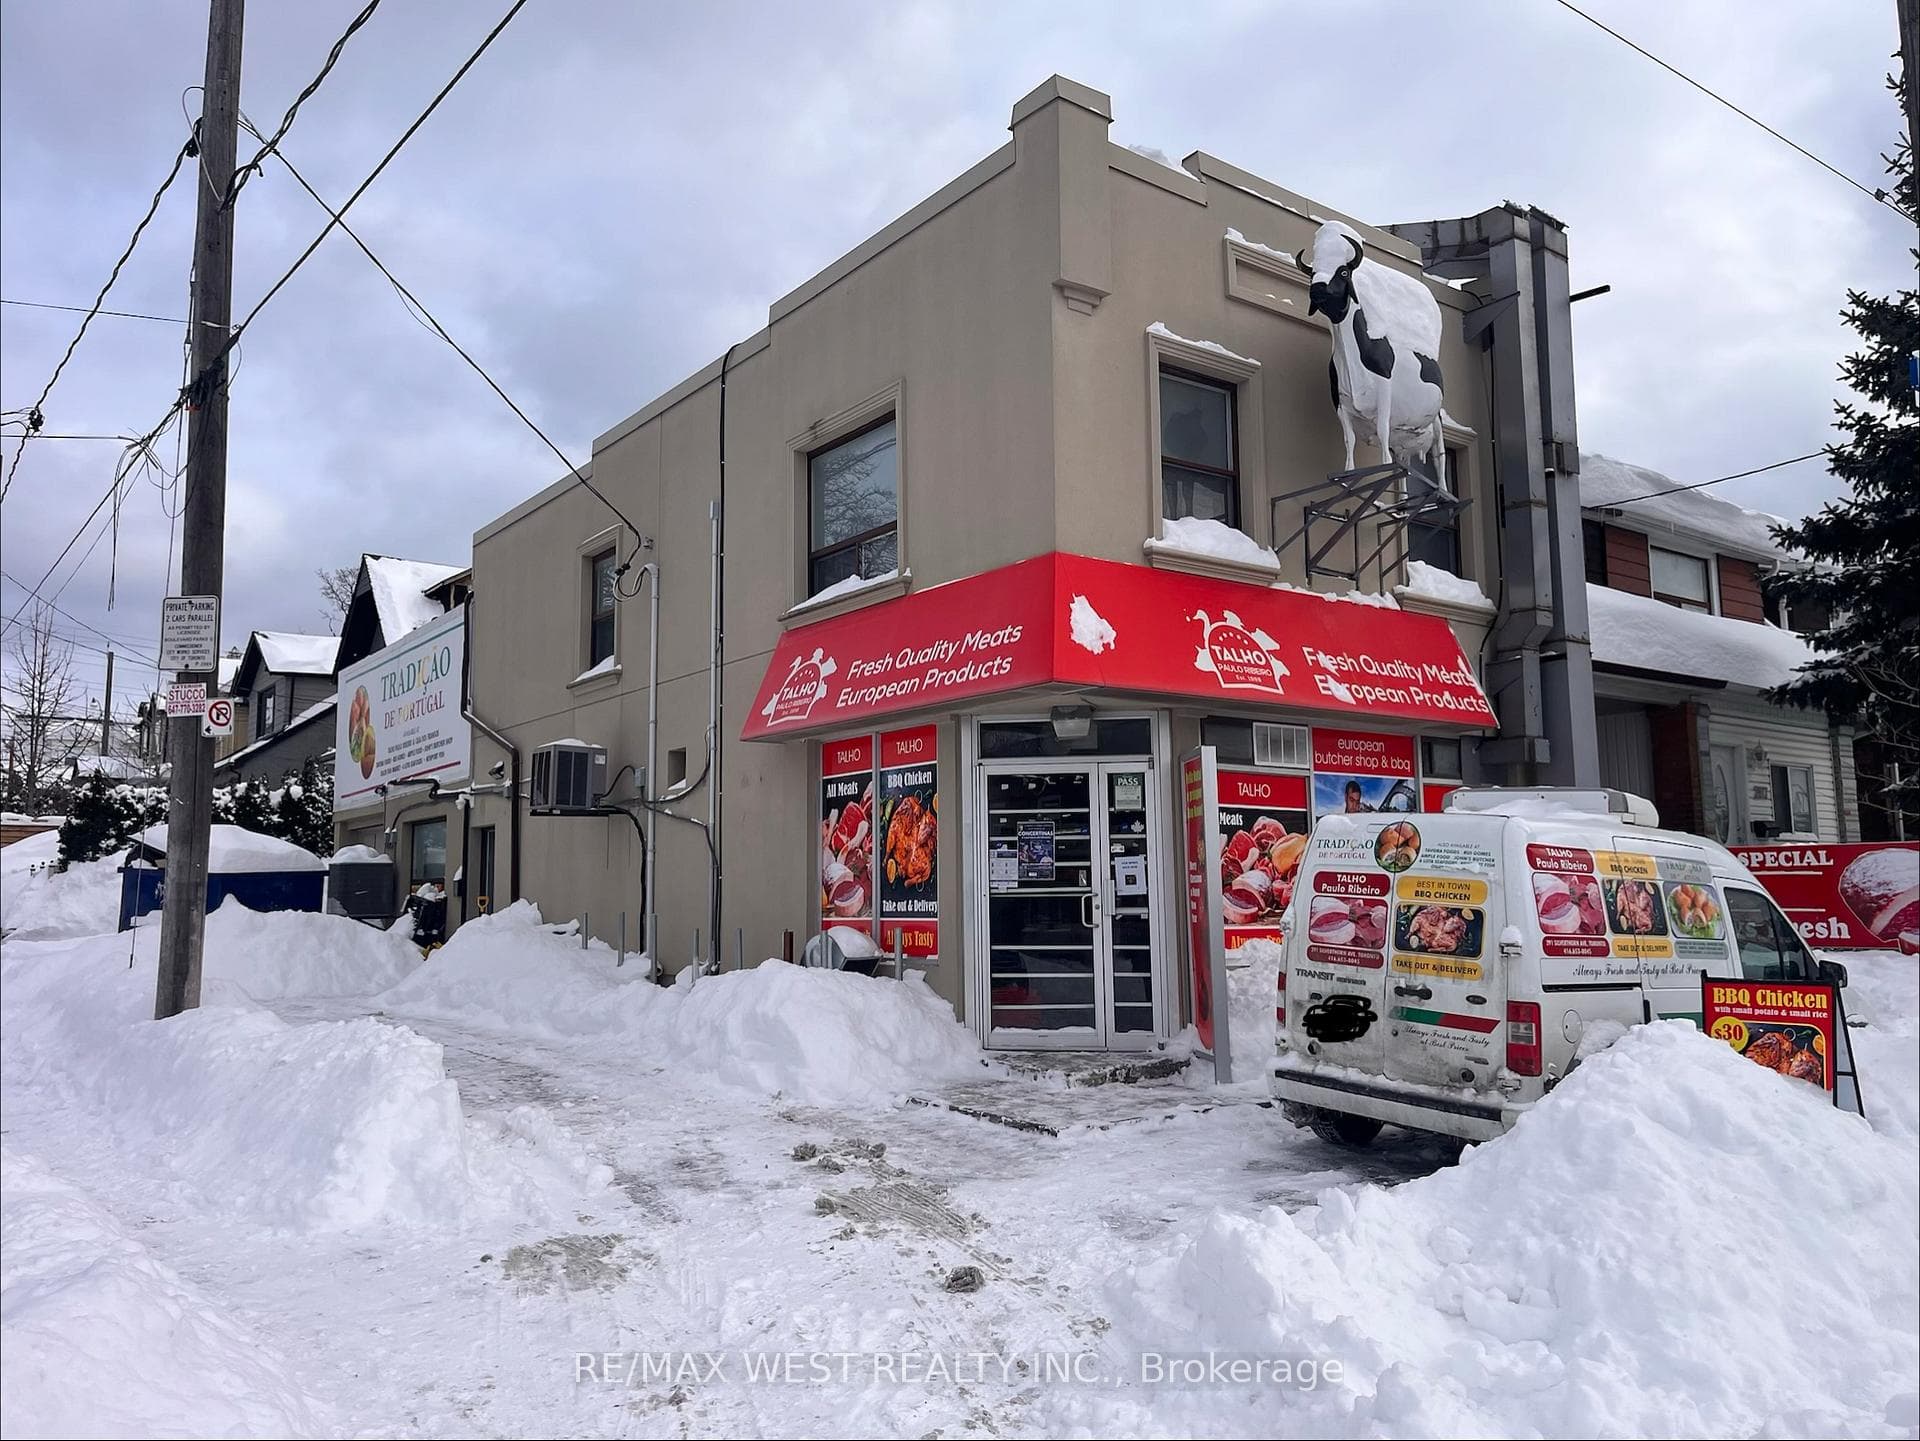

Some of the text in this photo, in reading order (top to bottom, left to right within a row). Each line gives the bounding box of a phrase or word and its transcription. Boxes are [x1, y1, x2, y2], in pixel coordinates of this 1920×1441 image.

[166, 602, 214, 611] PRIVATE PARKING
[172, 614, 186, 622] CARS
[187, 614, 214, 622] PARALLEL
[847, 623, 1024, 681] Fresh Quality Meats
[1210, 645, 1266, 666] TALHO
[1217, 663, 1272, 676] PAULO RIBEIRO
[1360, 654, 1423, 686] Quality
[1425, 664, 1476, 688] Meats
[836, 655, 1013, 708] European Products
[168, 688, 206, 700] STUCCO
[781, 681, 818, 701] TALHO
[1313, 674, 1490, 714] Eropean Products
[384, 711, 395, 730] DE
[896, 738, 924, 755] TALHO
[1338, 738, 1385, 753] european
[837, 748, 861, 764] TALHO
[1315, 752, 1411, 772] butcher shop & bbq
[887, 770, 932, 788] BBQ Chicken
[1117, 777, 1138, 786] PASS
[826, 781, 858, 798] All Meats
[1237, 782, 1270, 799] TALHO
[1220, 812, 1244, 826] Meats
[1546, 847, 1573, 858] TALHO
[1737, 850, 1834, 868] SPECIAL
[1536, 857, 1588, 872] Paulo Ribeiro
[1624, 865, 1648, 874] CHICKEN
[1336, 874, 1367, 884] TALHO
[1416, 880, 1471, 891] BEST IN TOWN
[1321, 883, 1380, 896] Paulo Ribeiro
[1414, 890, 1471, 901] BBQ CHICKEN
[882, 899, 938, 914] Take out & Delivery
[914, 931, 934, 948] Tasty
[1617, 944, 1629, 952] TAKE
[1646, 944, 1668, 954] DELIVERY
[1295, 968, 1335, 982] TRANSIT
[1395, 960, 1478, 976] TAKE OUT & DELIVERY
[1572, 963, 1602, 981] Always
[1604, 963, 1624, 976] Fresh
[1624, 964, 1639, 976] and
[1639, 964, 1660, 981] Tasty
[1661, 964, 1668, 975] at
[1668, 964, 1685, 975] Best
[1712, 987, 1828, 1009] BBQ Chicken
[1714, 1006, 1730, 1014] with
[1754, 1008, 1779, 1016] potato
[1789, 1010, 1811, 1018] small
[1430, 1030, 1450, 1040] Fresh
[1452, 1034, 1467, 1042] and
[1468, 1035, 1490, 1048] Tasty
[1714, 1023, 1744, 1041] $30
[1429, 1039, 1446, 1048] Best
